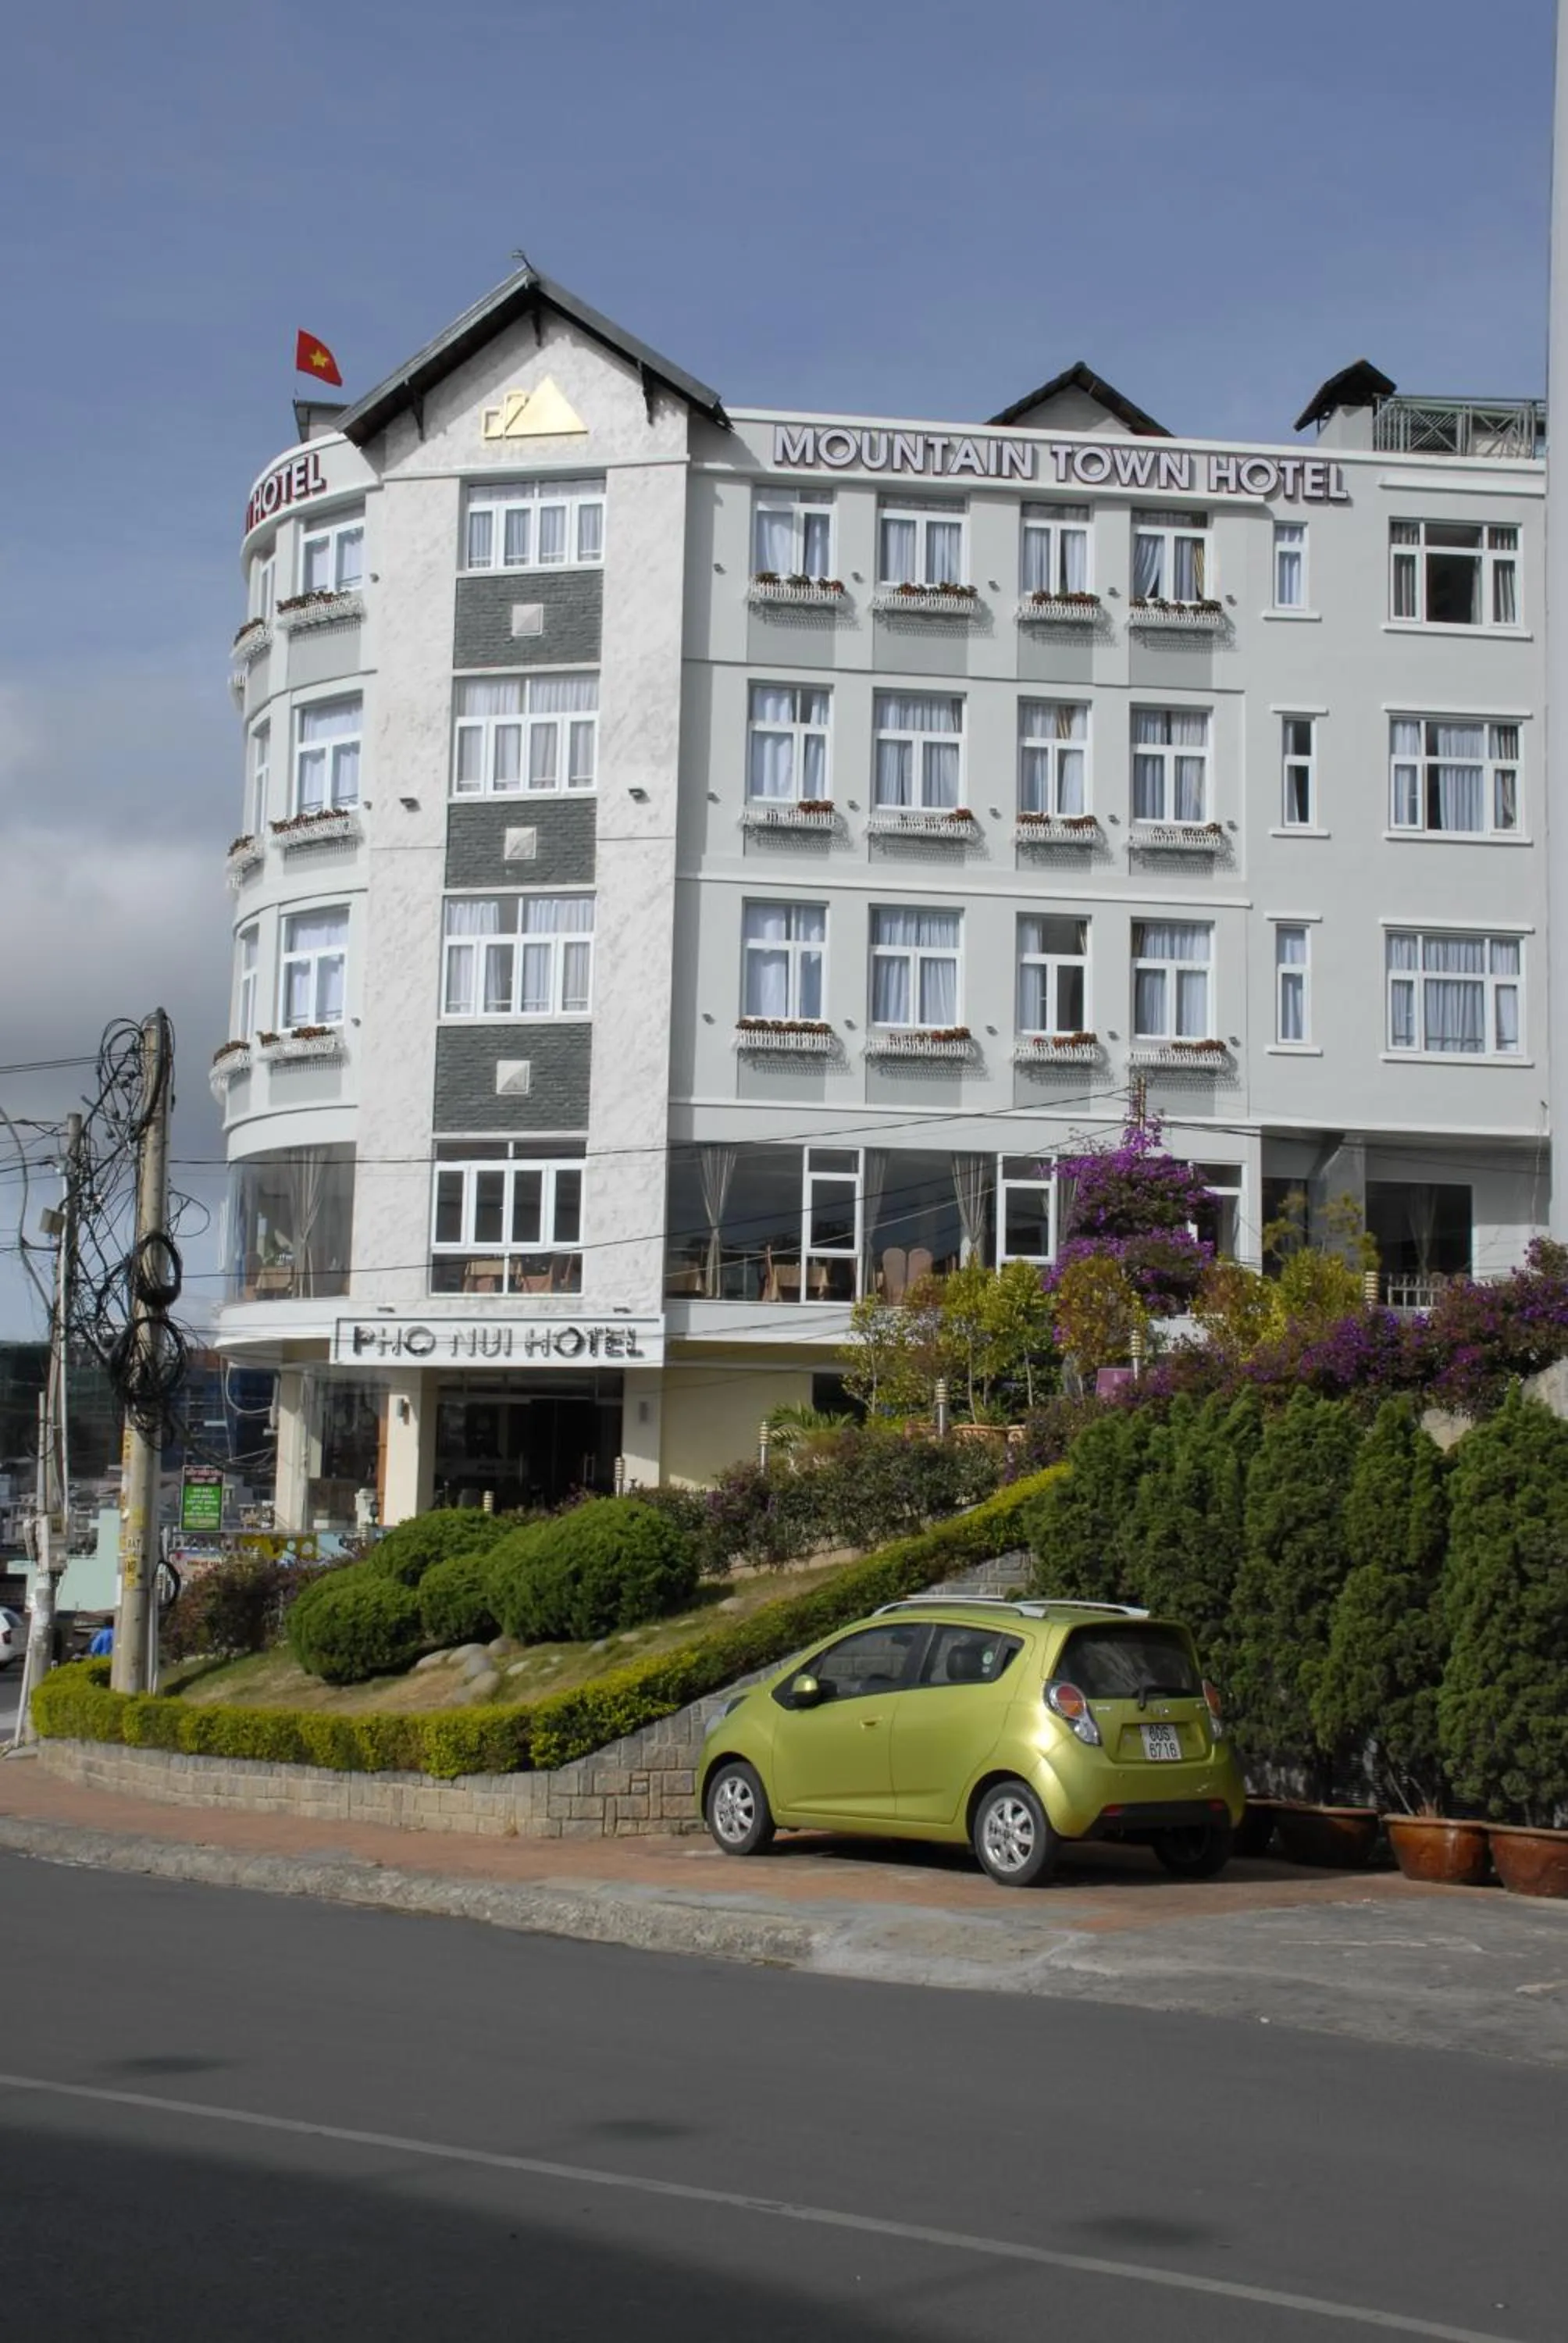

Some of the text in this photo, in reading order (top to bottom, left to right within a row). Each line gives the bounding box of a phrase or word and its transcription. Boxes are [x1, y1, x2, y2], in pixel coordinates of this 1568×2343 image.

[251, 452, 327, 525] HOTEL
[774, 426, 1349, 500] MOUNTAIN TOWN HOTEL
[353, 1325, 645, 1358] PHO NUI HOTEL
